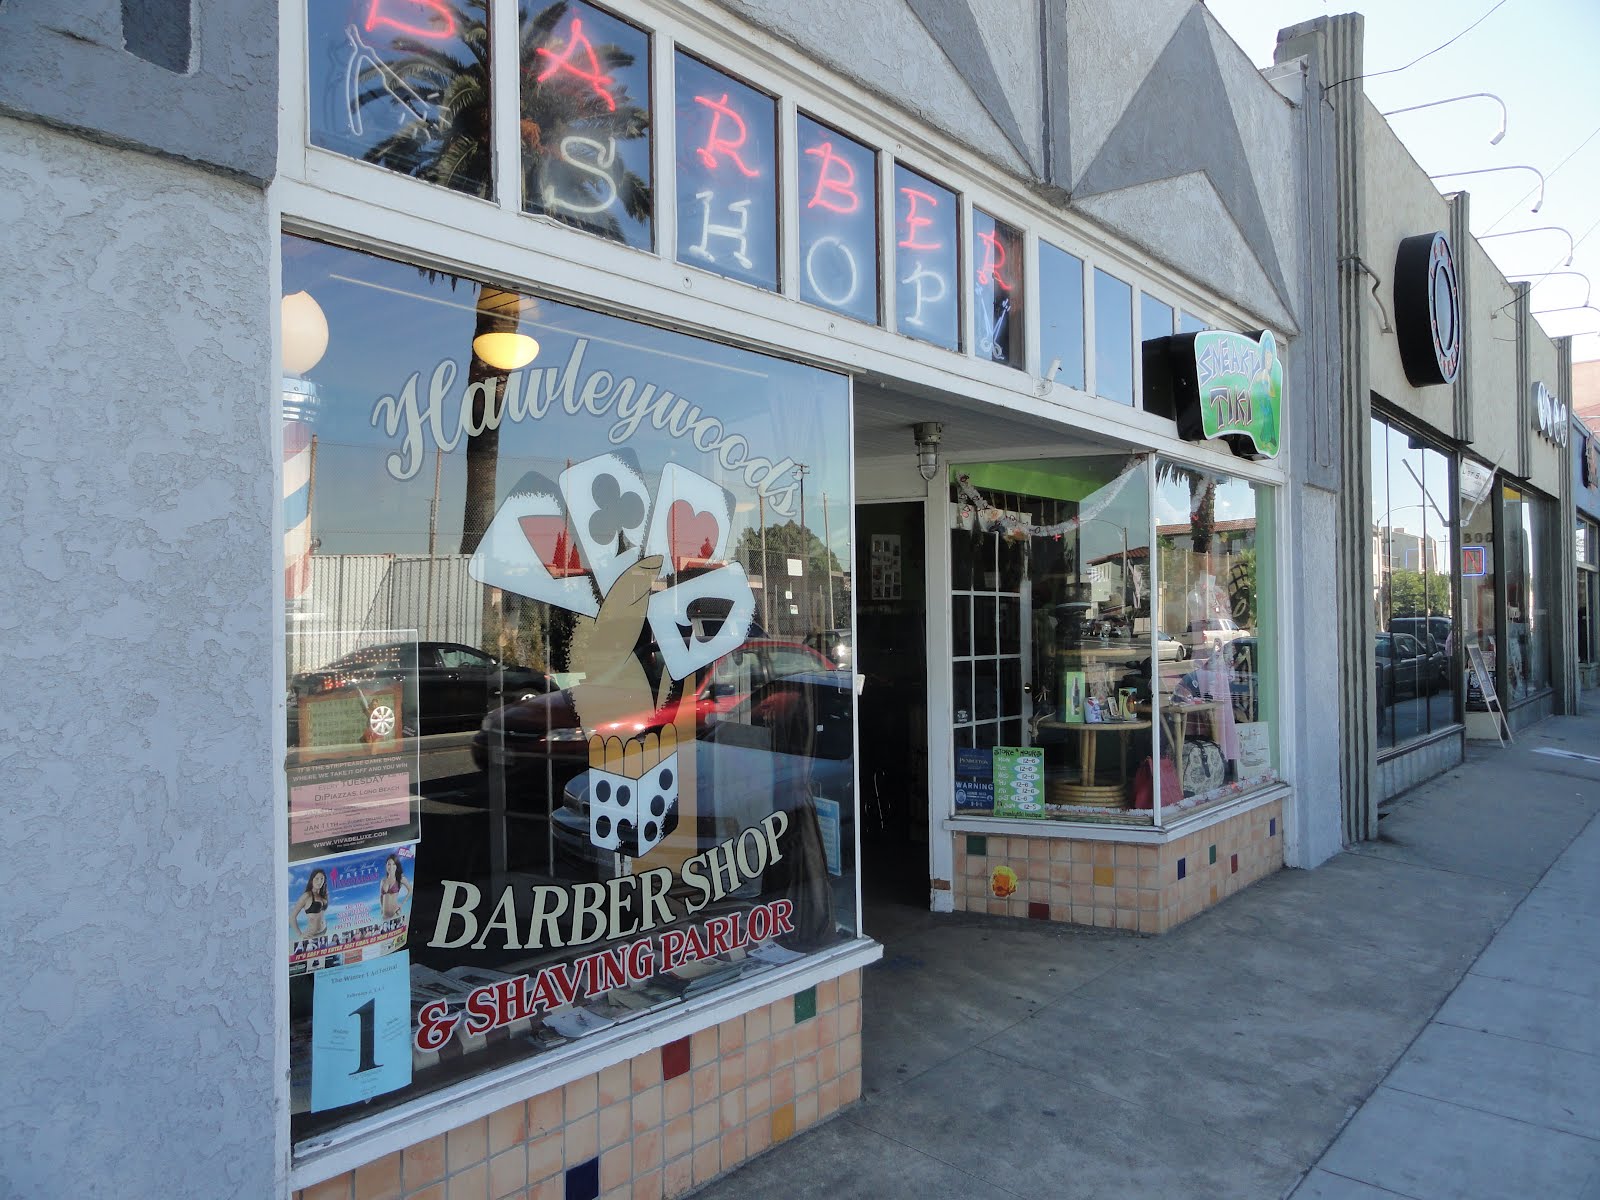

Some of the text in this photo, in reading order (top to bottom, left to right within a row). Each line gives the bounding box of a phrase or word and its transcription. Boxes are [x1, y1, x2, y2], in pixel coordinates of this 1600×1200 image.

[543, 136, 946, 327] SHOP
[1197, 337, 1262, 391] SNEAKY
[1209, 386, 1253, 430] TIKI
[371, 337, 806, 518] Hawleywood's
[383, 755, 401, 763] SHOW
[292, 774, 317, 782] WHERE
[342, 775, 384, 787] TUESDAY
[956, 781, 994, 790] WARNING
[304, 823, 320, 832] JAN
[340, 867, 379, 880] PRETTY
[427, 810, 790, 950] BARBER SHOP
[343, 973, 365, 981] Winter
[414, 899, 795, 1052] & SHAVING PARLOR
[348, 998, 384, 1076] 1
